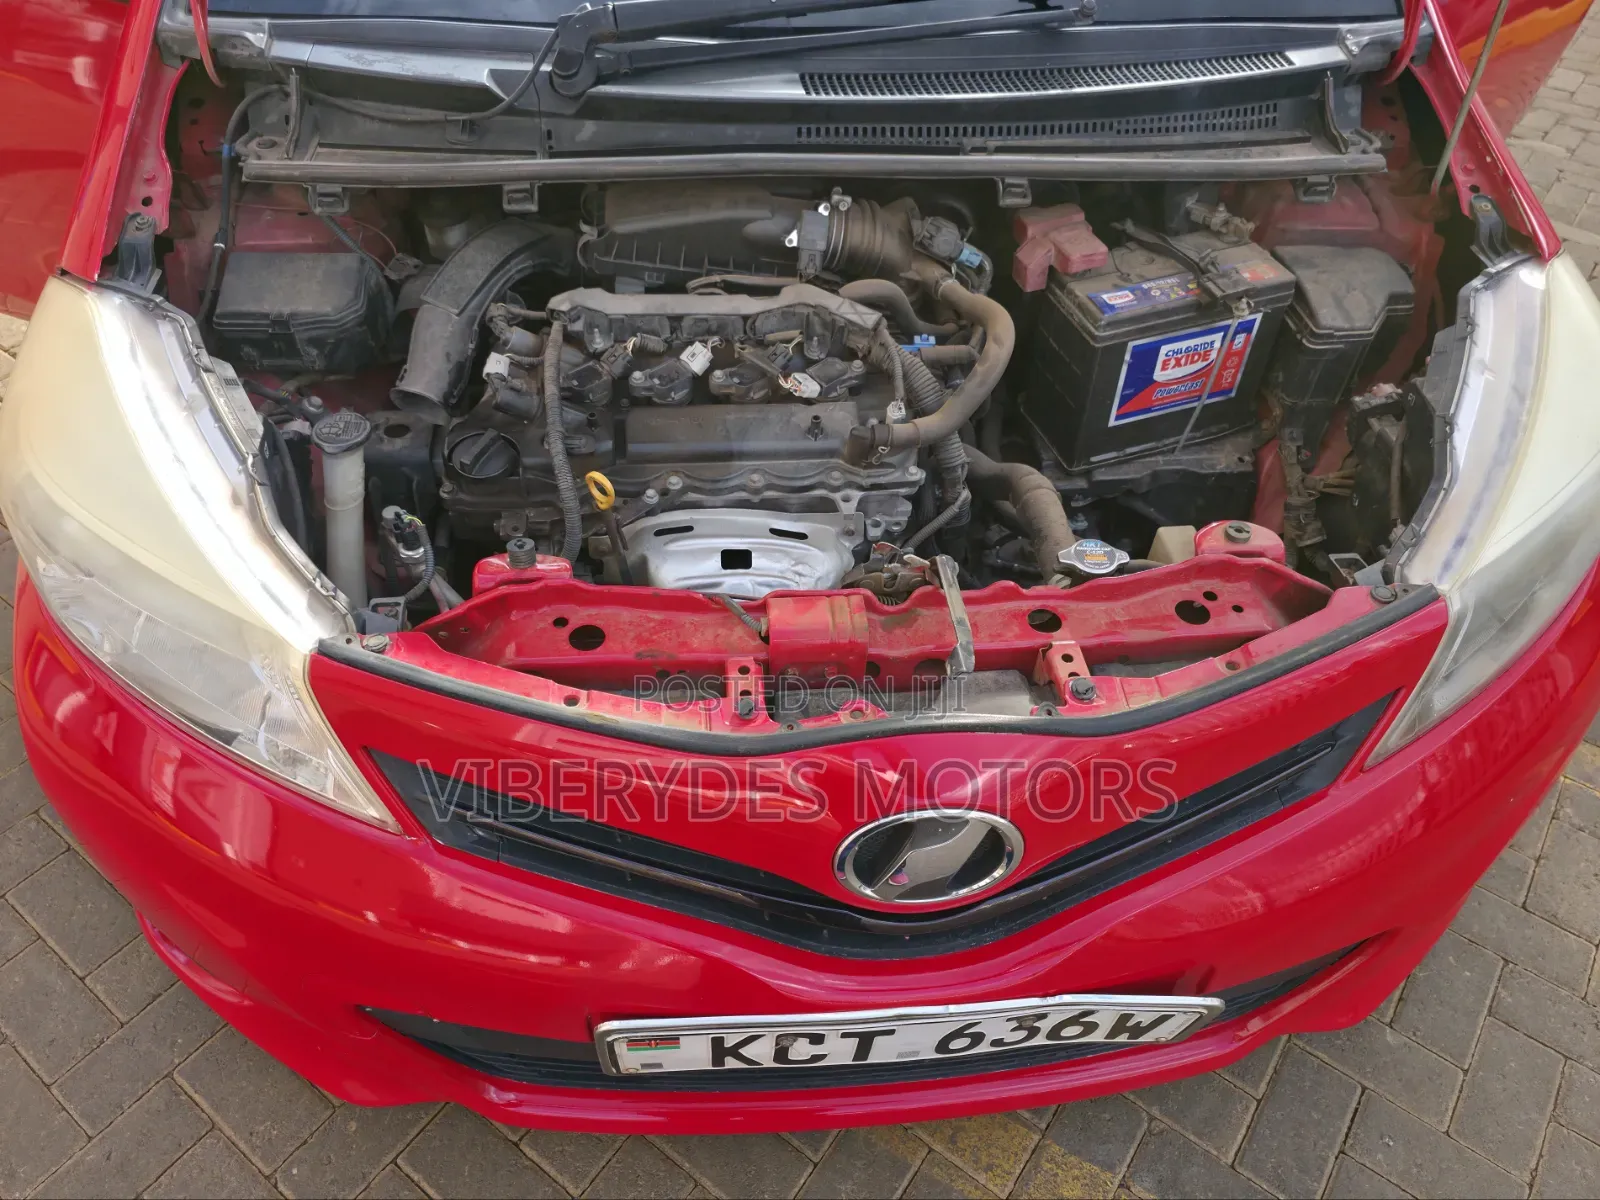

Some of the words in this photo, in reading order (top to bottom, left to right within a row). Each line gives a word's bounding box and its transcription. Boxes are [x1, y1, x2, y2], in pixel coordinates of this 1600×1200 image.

[1165, 340, 1216, 357] CHLORIDE
[1160, 349, 1213, 372] EXIDE
[711, 1029, 896, 1068] KCT
[934, 1010, 1176, 1056] 636W
